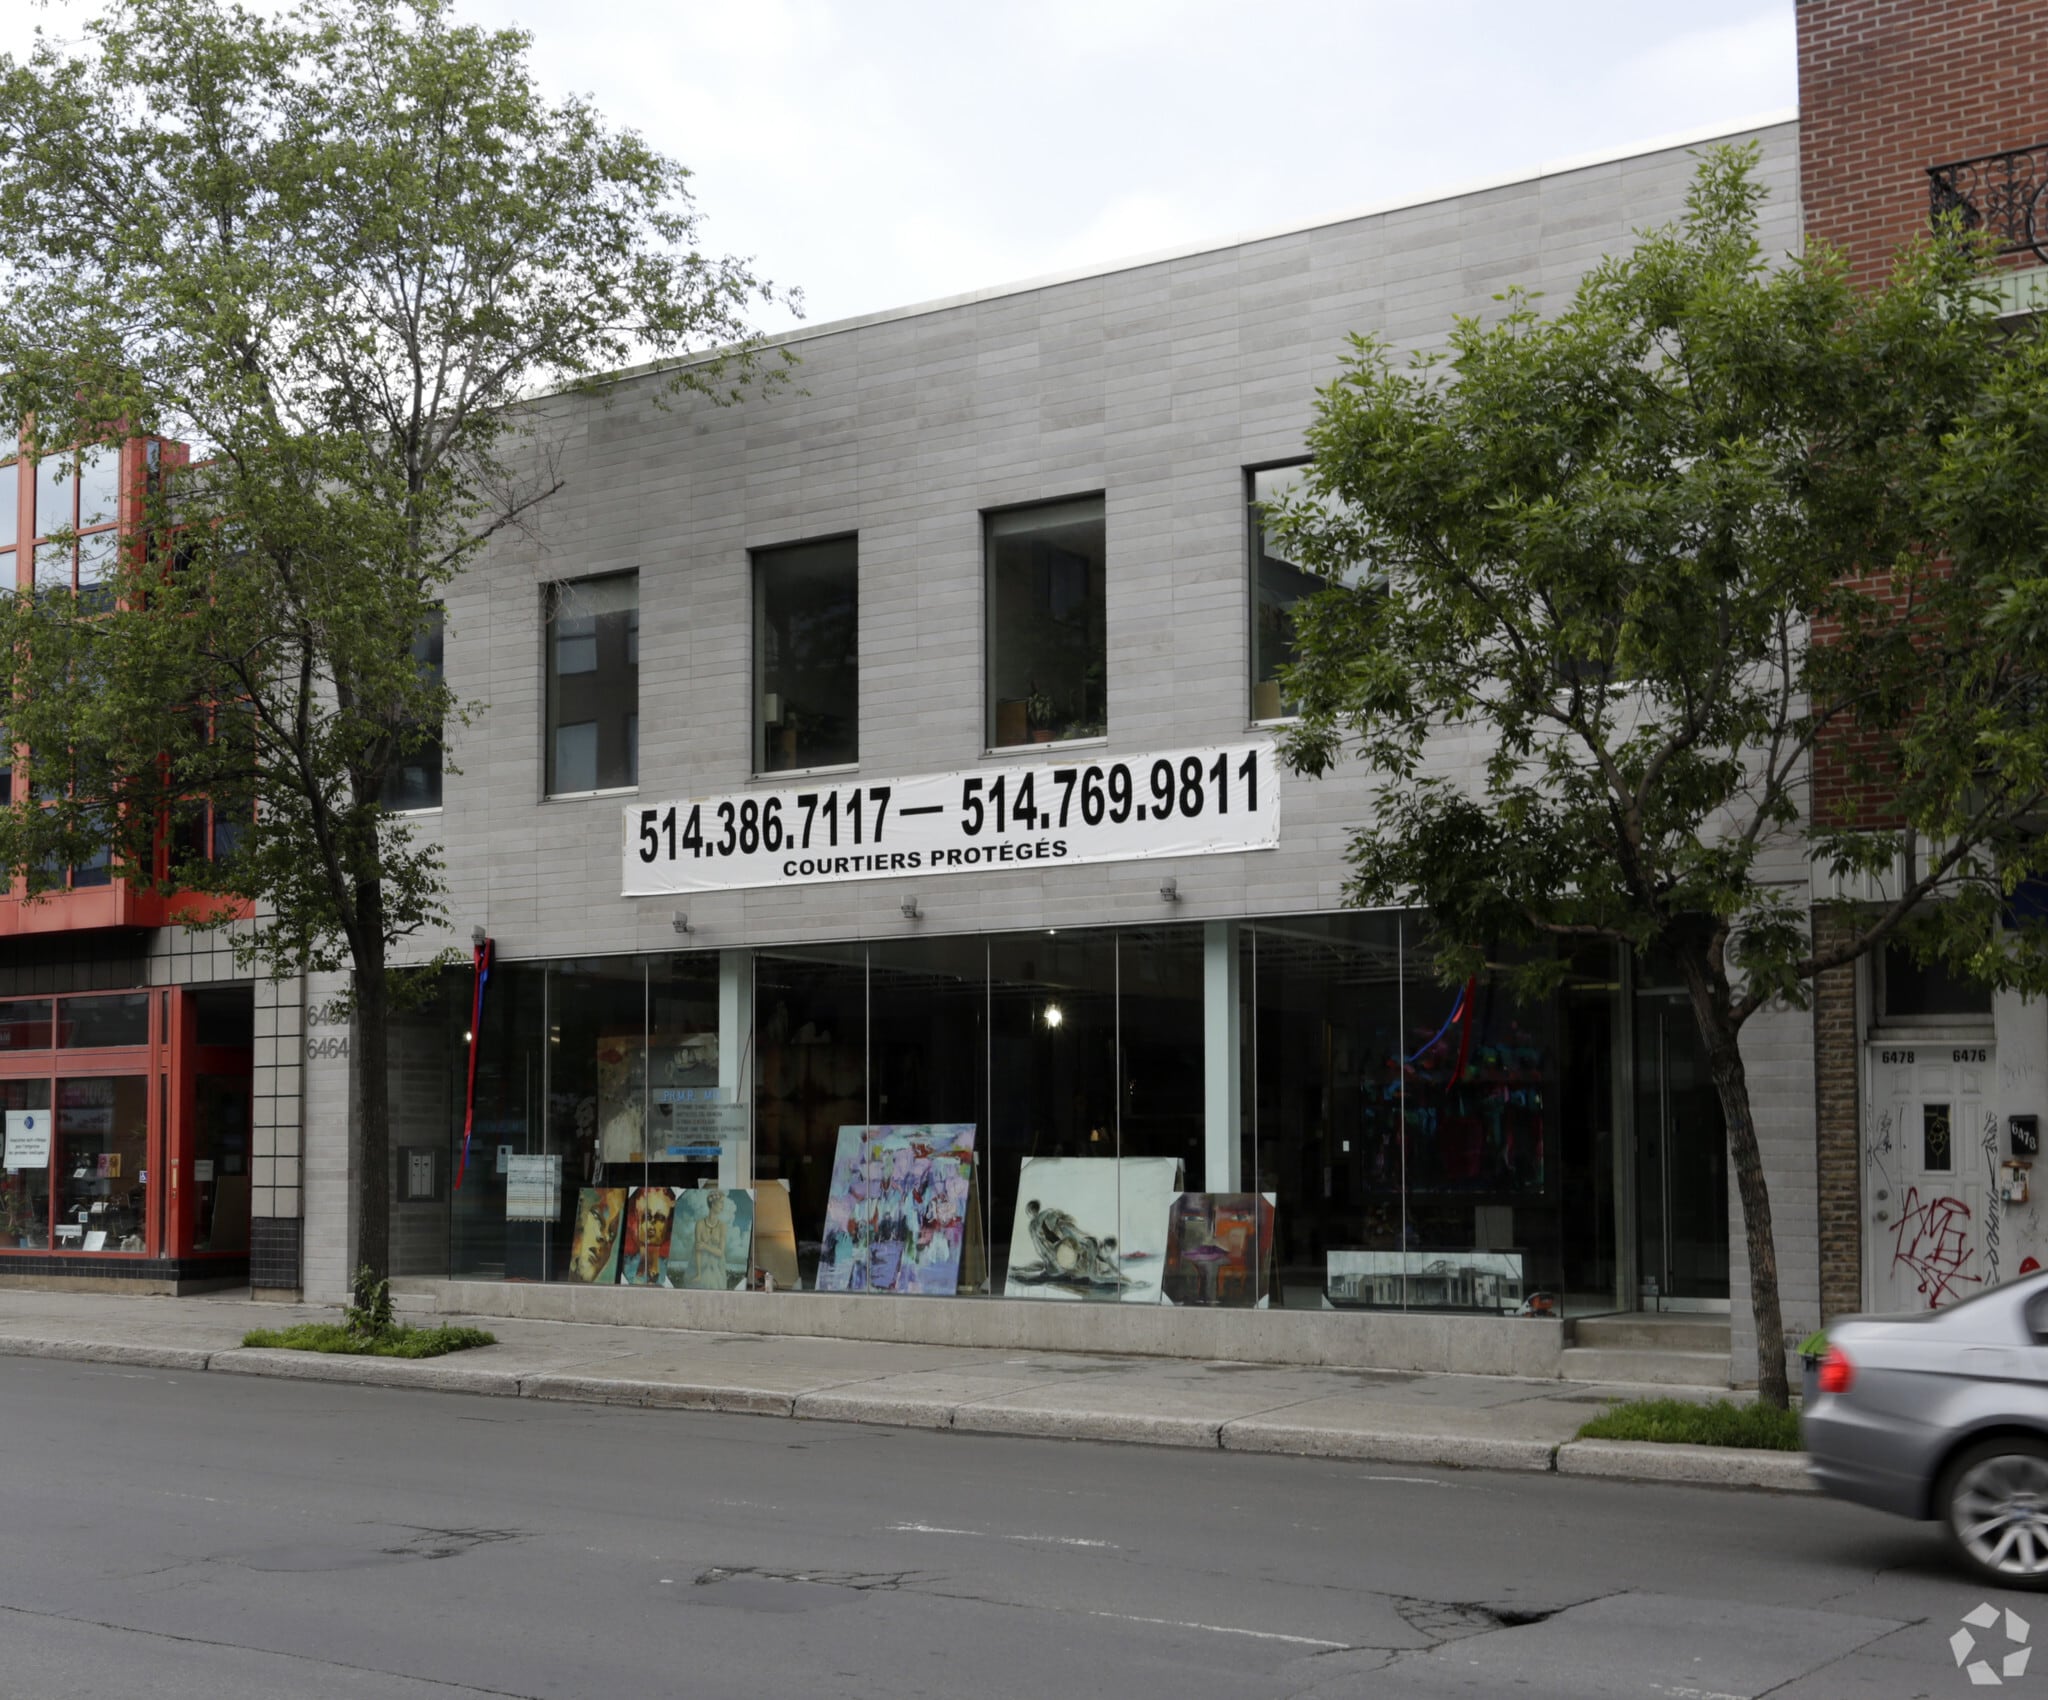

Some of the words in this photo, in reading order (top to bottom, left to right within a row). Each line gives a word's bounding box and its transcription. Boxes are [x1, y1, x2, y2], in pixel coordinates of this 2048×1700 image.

[639, 785, 891, 863] 514.386.7117
[961, 750, 1257, 836] 514.769.9811
[783, 851, 921, 876] COURTIERS
[931, 840, 1068, 867] PROTÉGÉS
[307, 1037, 349, 1060] 6464
[1882, 1051, 1915, 1064] 6478
[1953, 1049, 1986, 1062] 6476
[2011, 1122, 2037, 1150] 6478
